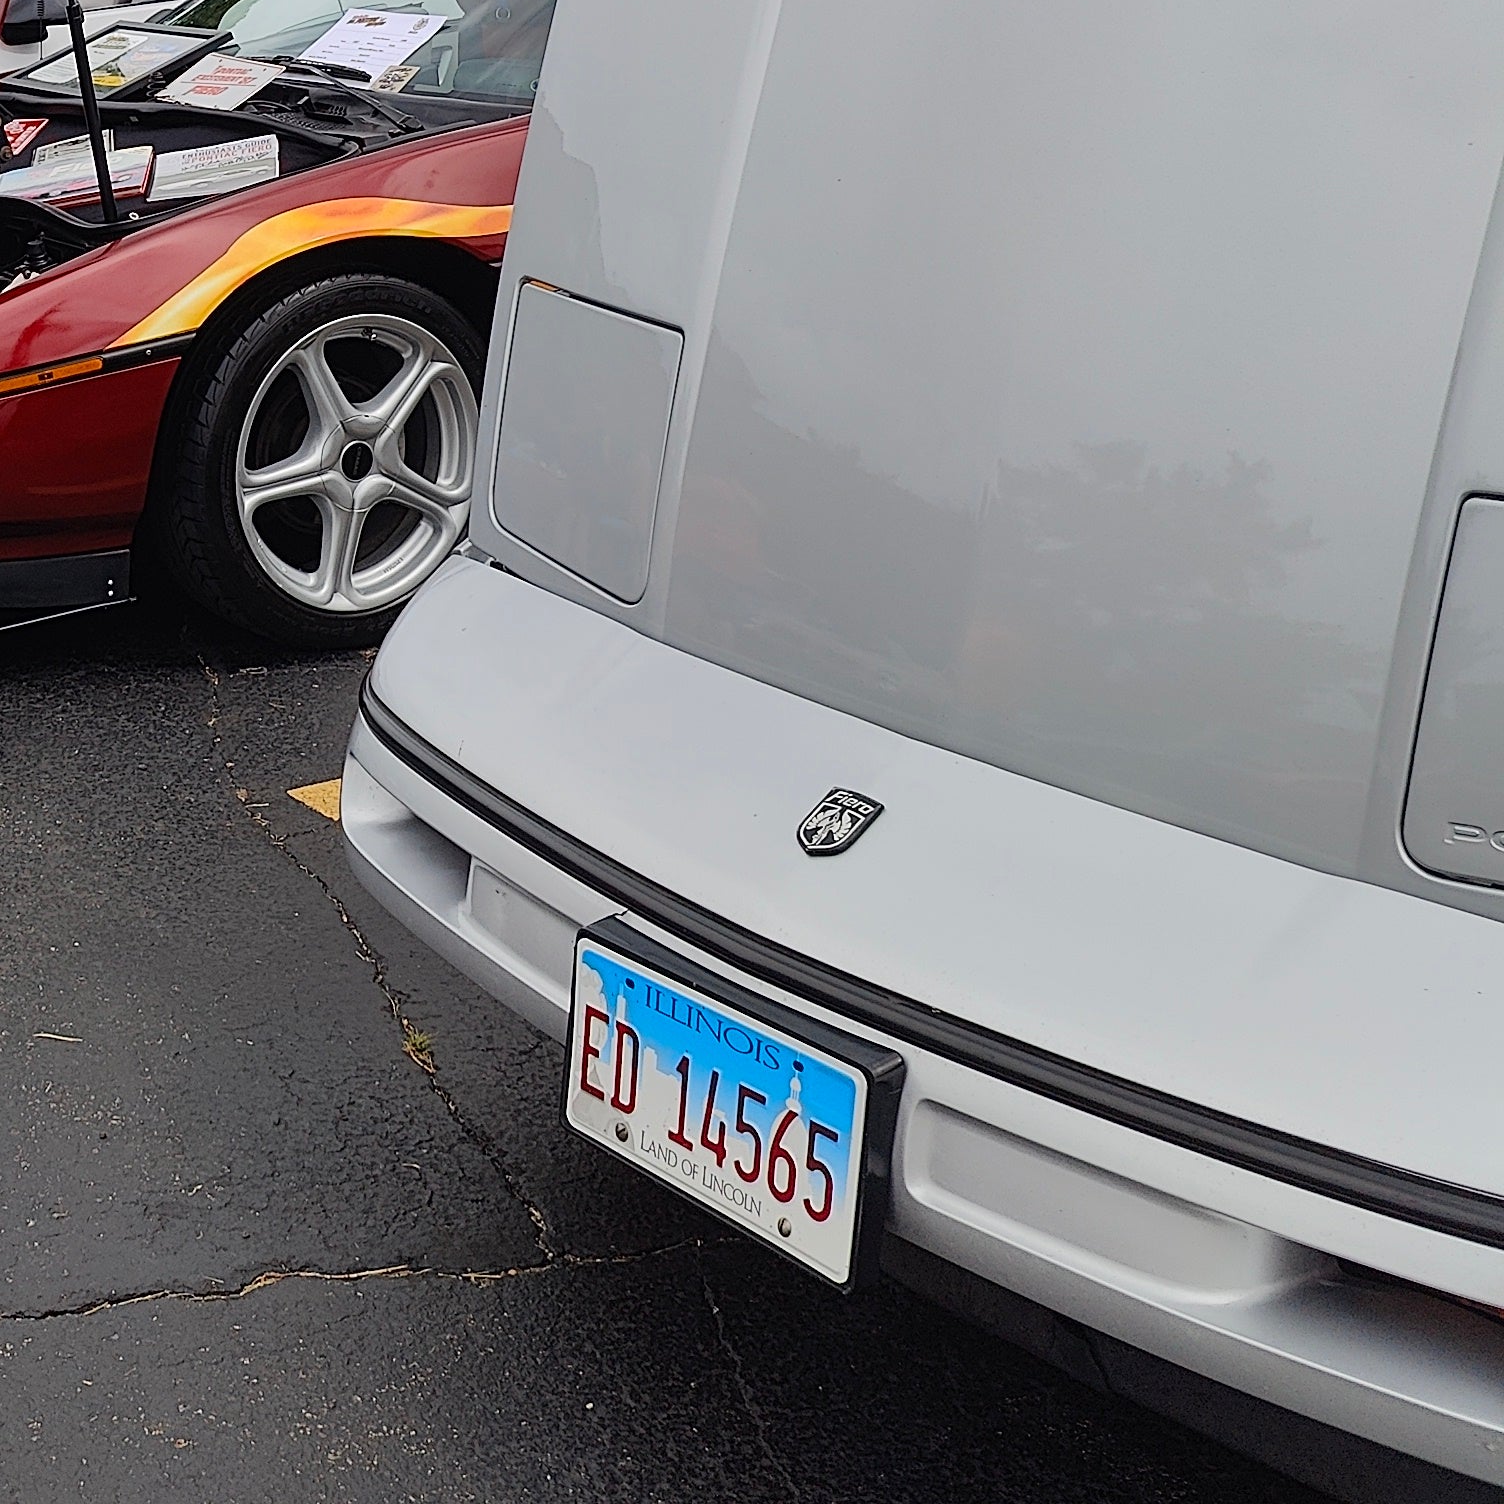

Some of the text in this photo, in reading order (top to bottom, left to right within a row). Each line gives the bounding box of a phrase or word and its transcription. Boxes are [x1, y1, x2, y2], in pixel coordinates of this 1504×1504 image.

[824, 790, 875, 815] Fiero
[645, 984, 780, 1071] ILLINOIS
[580, 1004, 839, 1222] ED 14565
[640, 1130, 762, 1217] LAND OF LINCOLN
